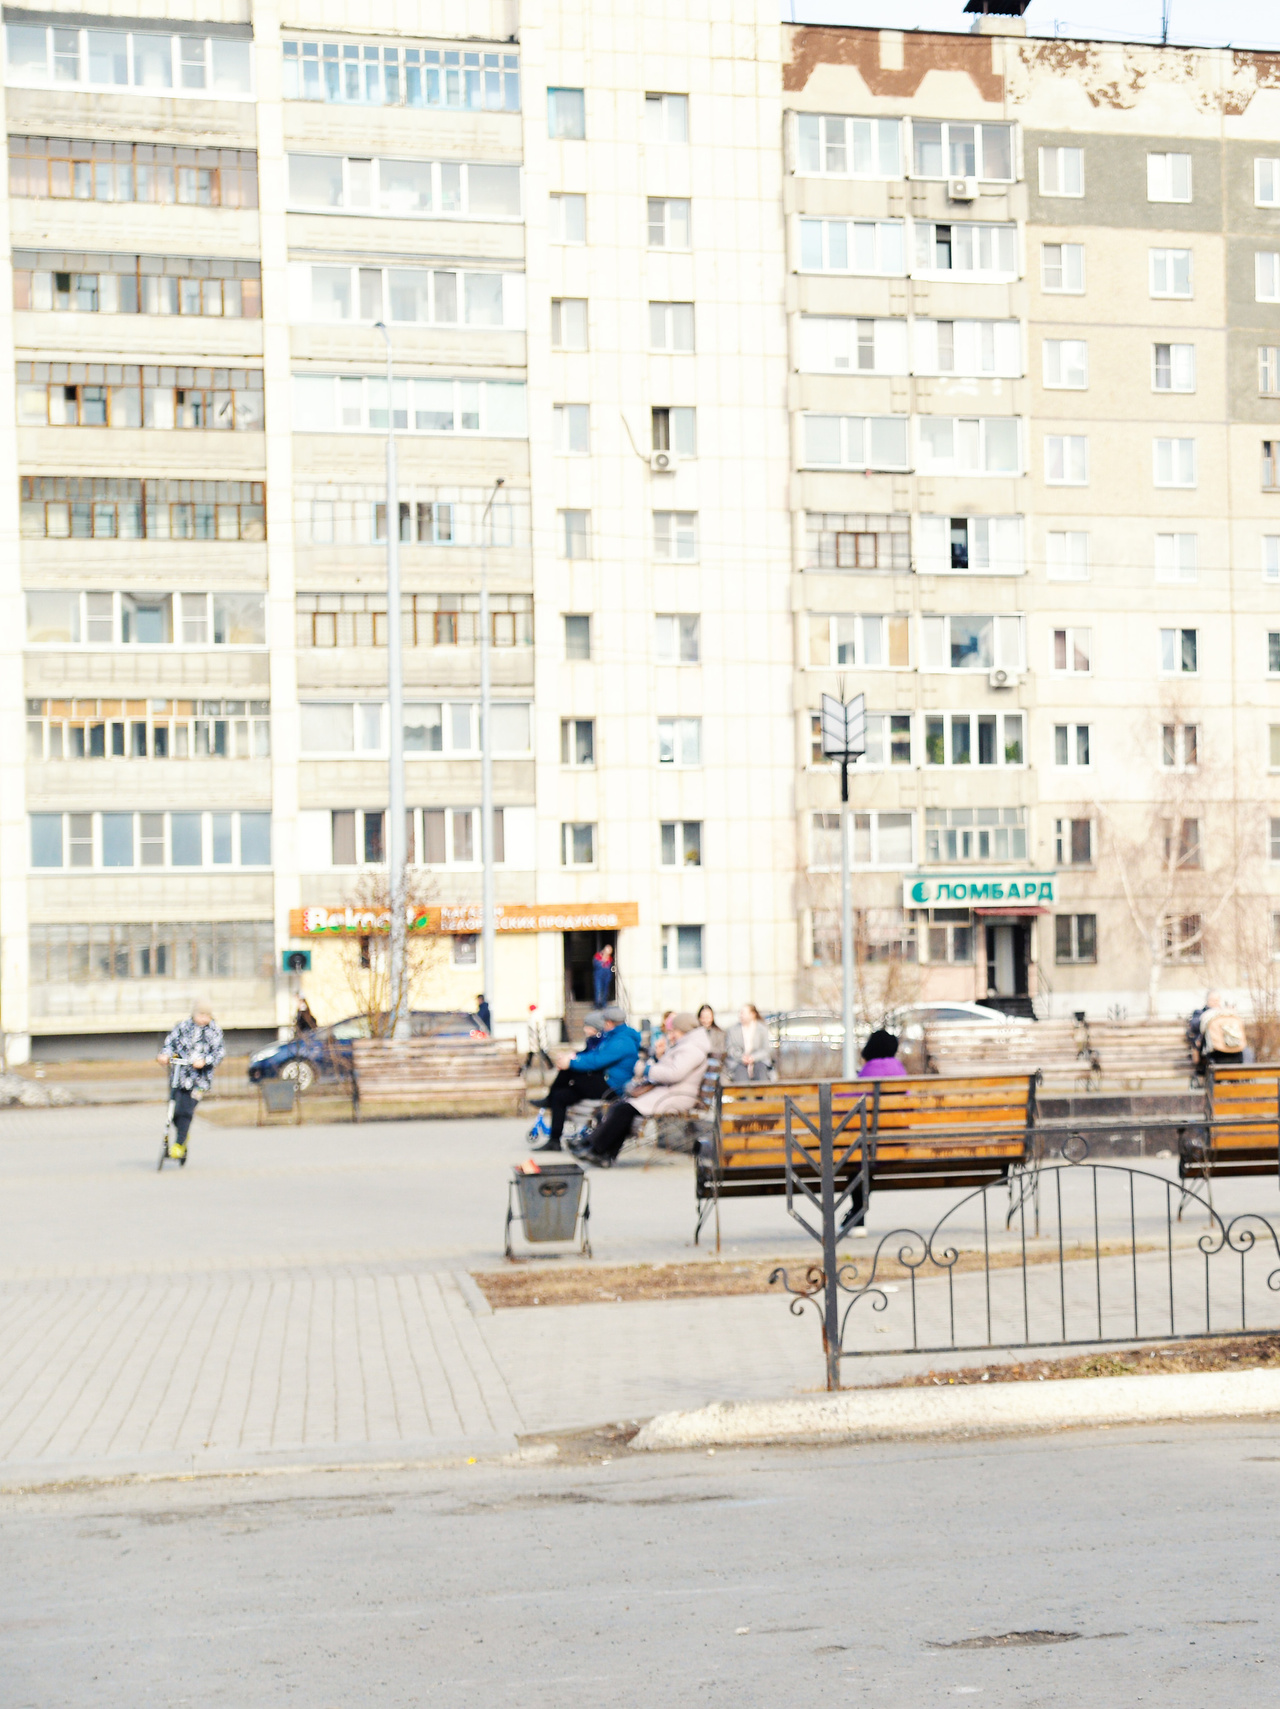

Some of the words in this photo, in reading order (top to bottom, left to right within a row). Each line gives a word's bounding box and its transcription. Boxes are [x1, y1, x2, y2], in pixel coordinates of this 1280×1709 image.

[936, 882, 1053, 901] ЛОМБАРД
[441, 906, 504, 918] МАГАН
[538, 914, 618, 929] ПРОДУКТОВ
